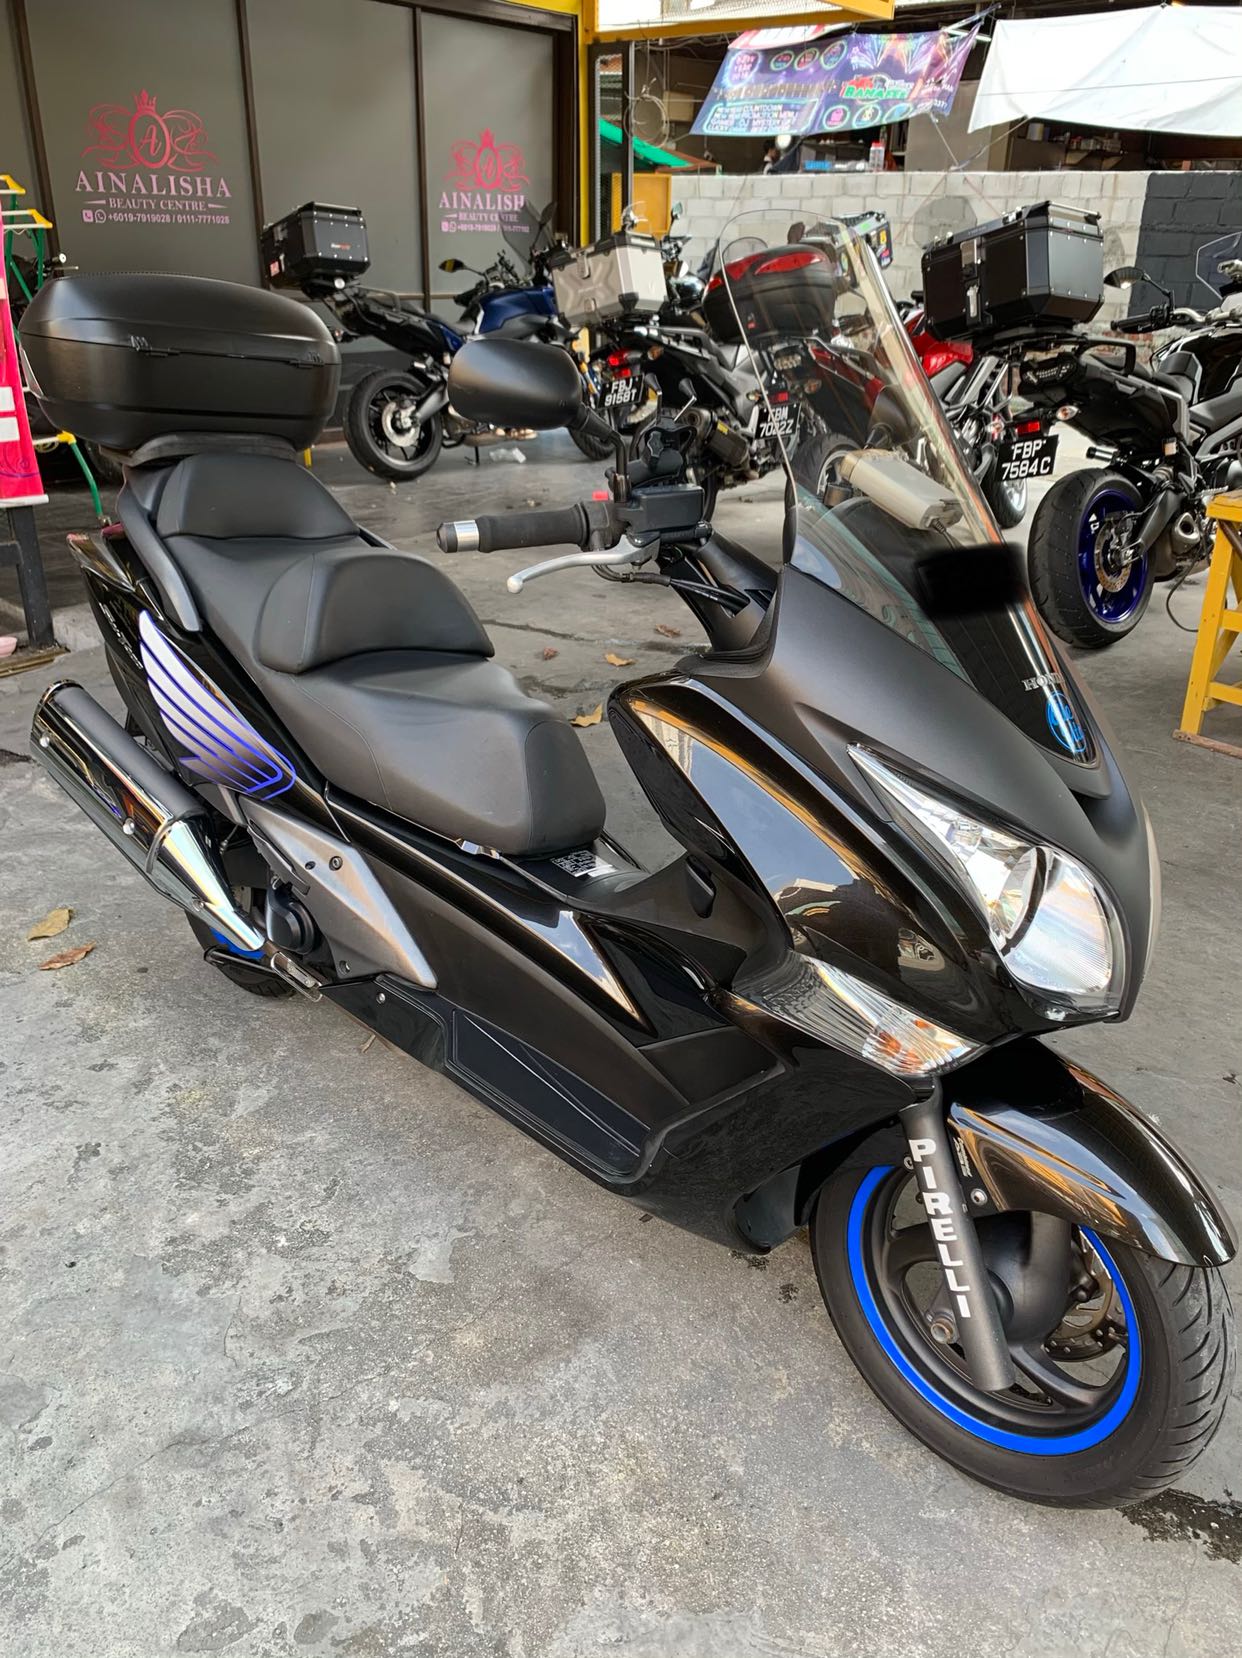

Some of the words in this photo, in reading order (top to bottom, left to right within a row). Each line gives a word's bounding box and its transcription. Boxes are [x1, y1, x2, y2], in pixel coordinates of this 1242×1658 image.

[75, 170, 232, 198] AINALISHA
[109, 197, 157, 209] BEAUTY
[160, 200, 207, 212] CENTRE
[439, 191, 525, 211] AINALISH
[611, 378, 633, 394] FBJ
[1012, 439, 1043, 460] FBP
[1001, 456, 1051, 480] 7584C
[1022, 672, 1065, 692] HOND
[908, 1138, 972, 1318] PIRELLI
